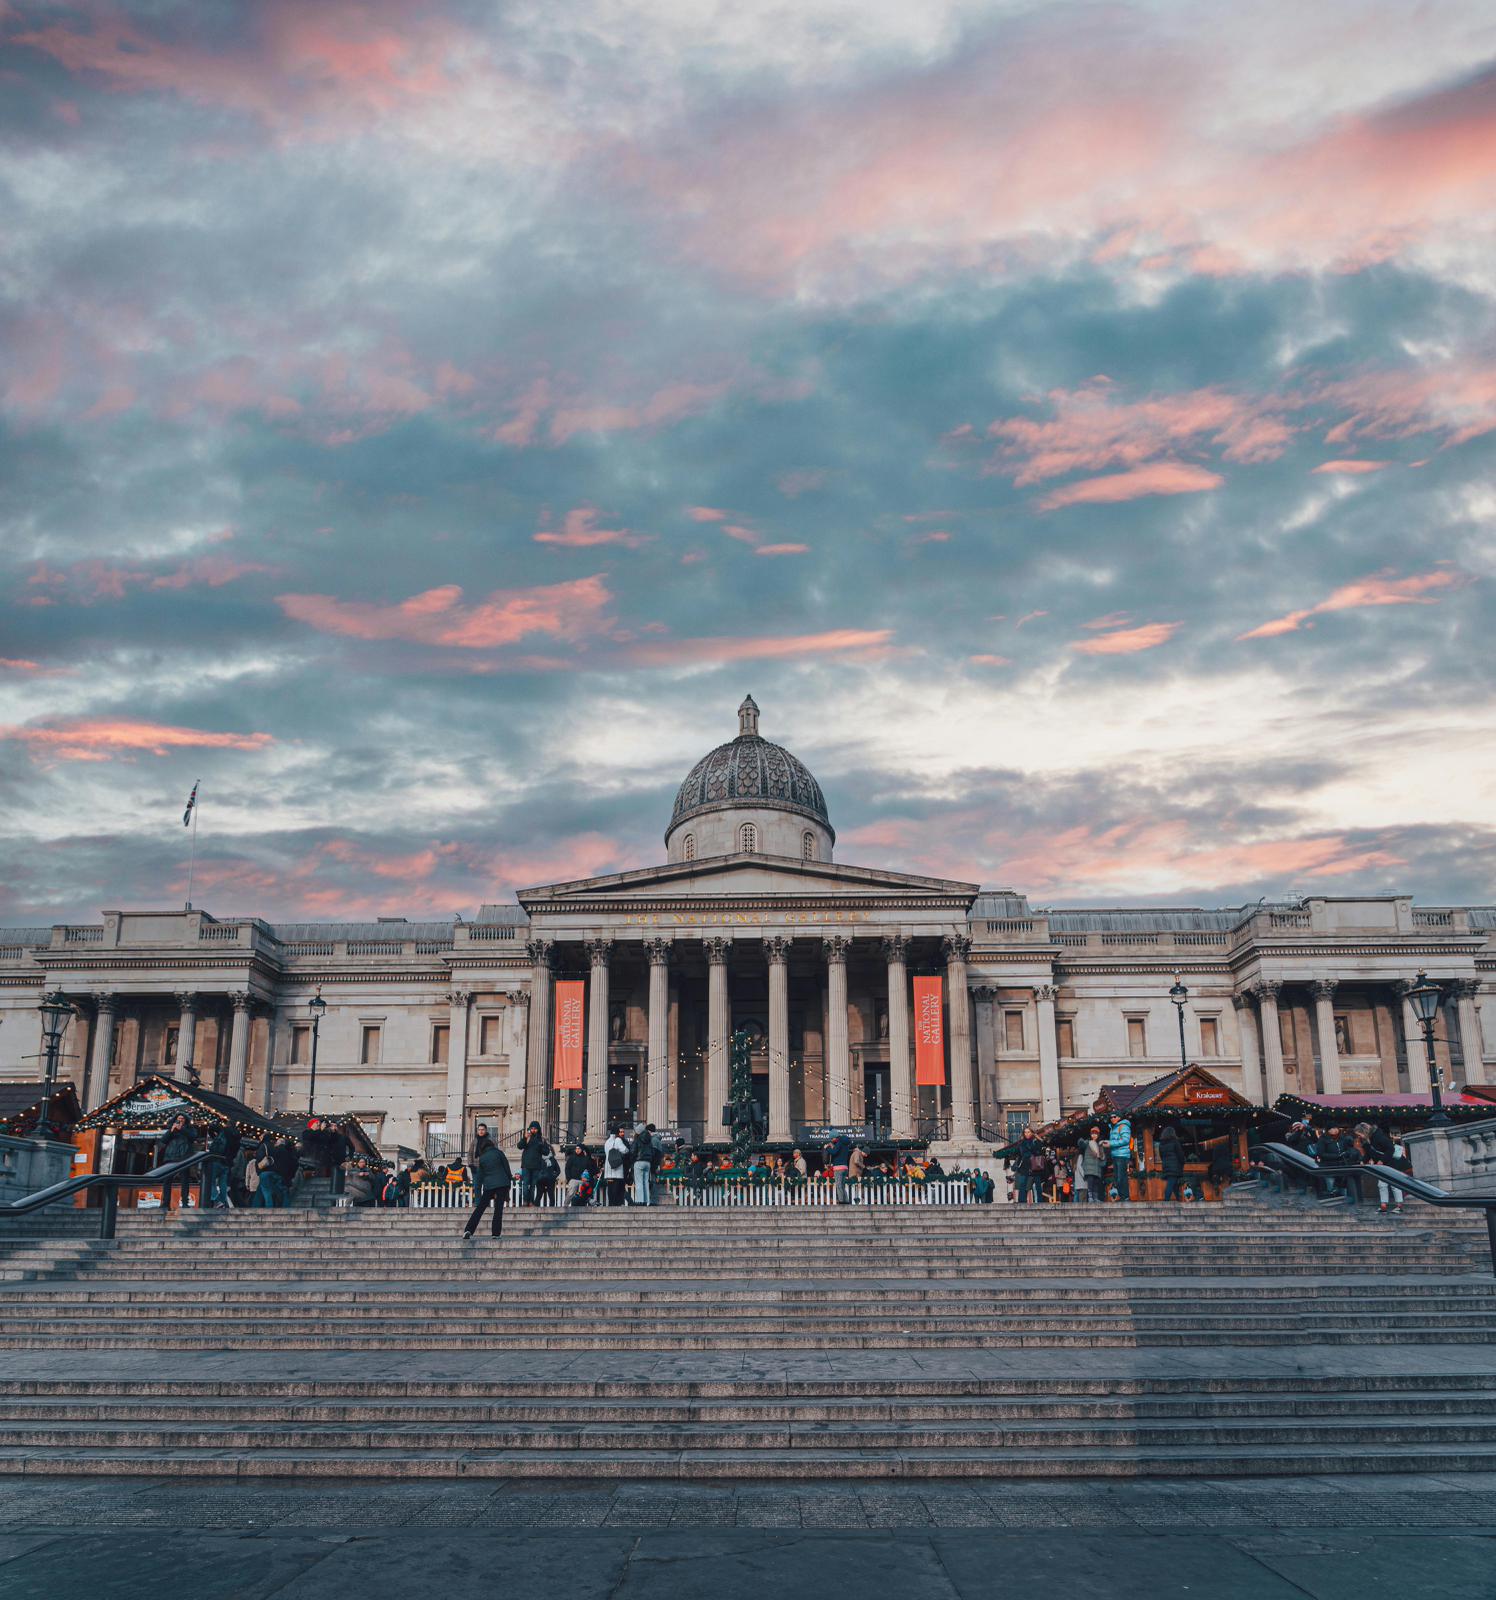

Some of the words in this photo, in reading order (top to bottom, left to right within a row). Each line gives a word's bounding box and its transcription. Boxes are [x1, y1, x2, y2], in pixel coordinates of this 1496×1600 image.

[624, 913, 659, 925] THE
[673, 912, 772, 924] NATIONAL
[784, 911, 872, 923] GALLERY
[562, 998, 571, 1048] NATIONAL
[571, 998, 580, 1048] GALLERY
[922, 994, 931, 1044] NATIONAL
[931, 994, 940, 1044] GALLERY
